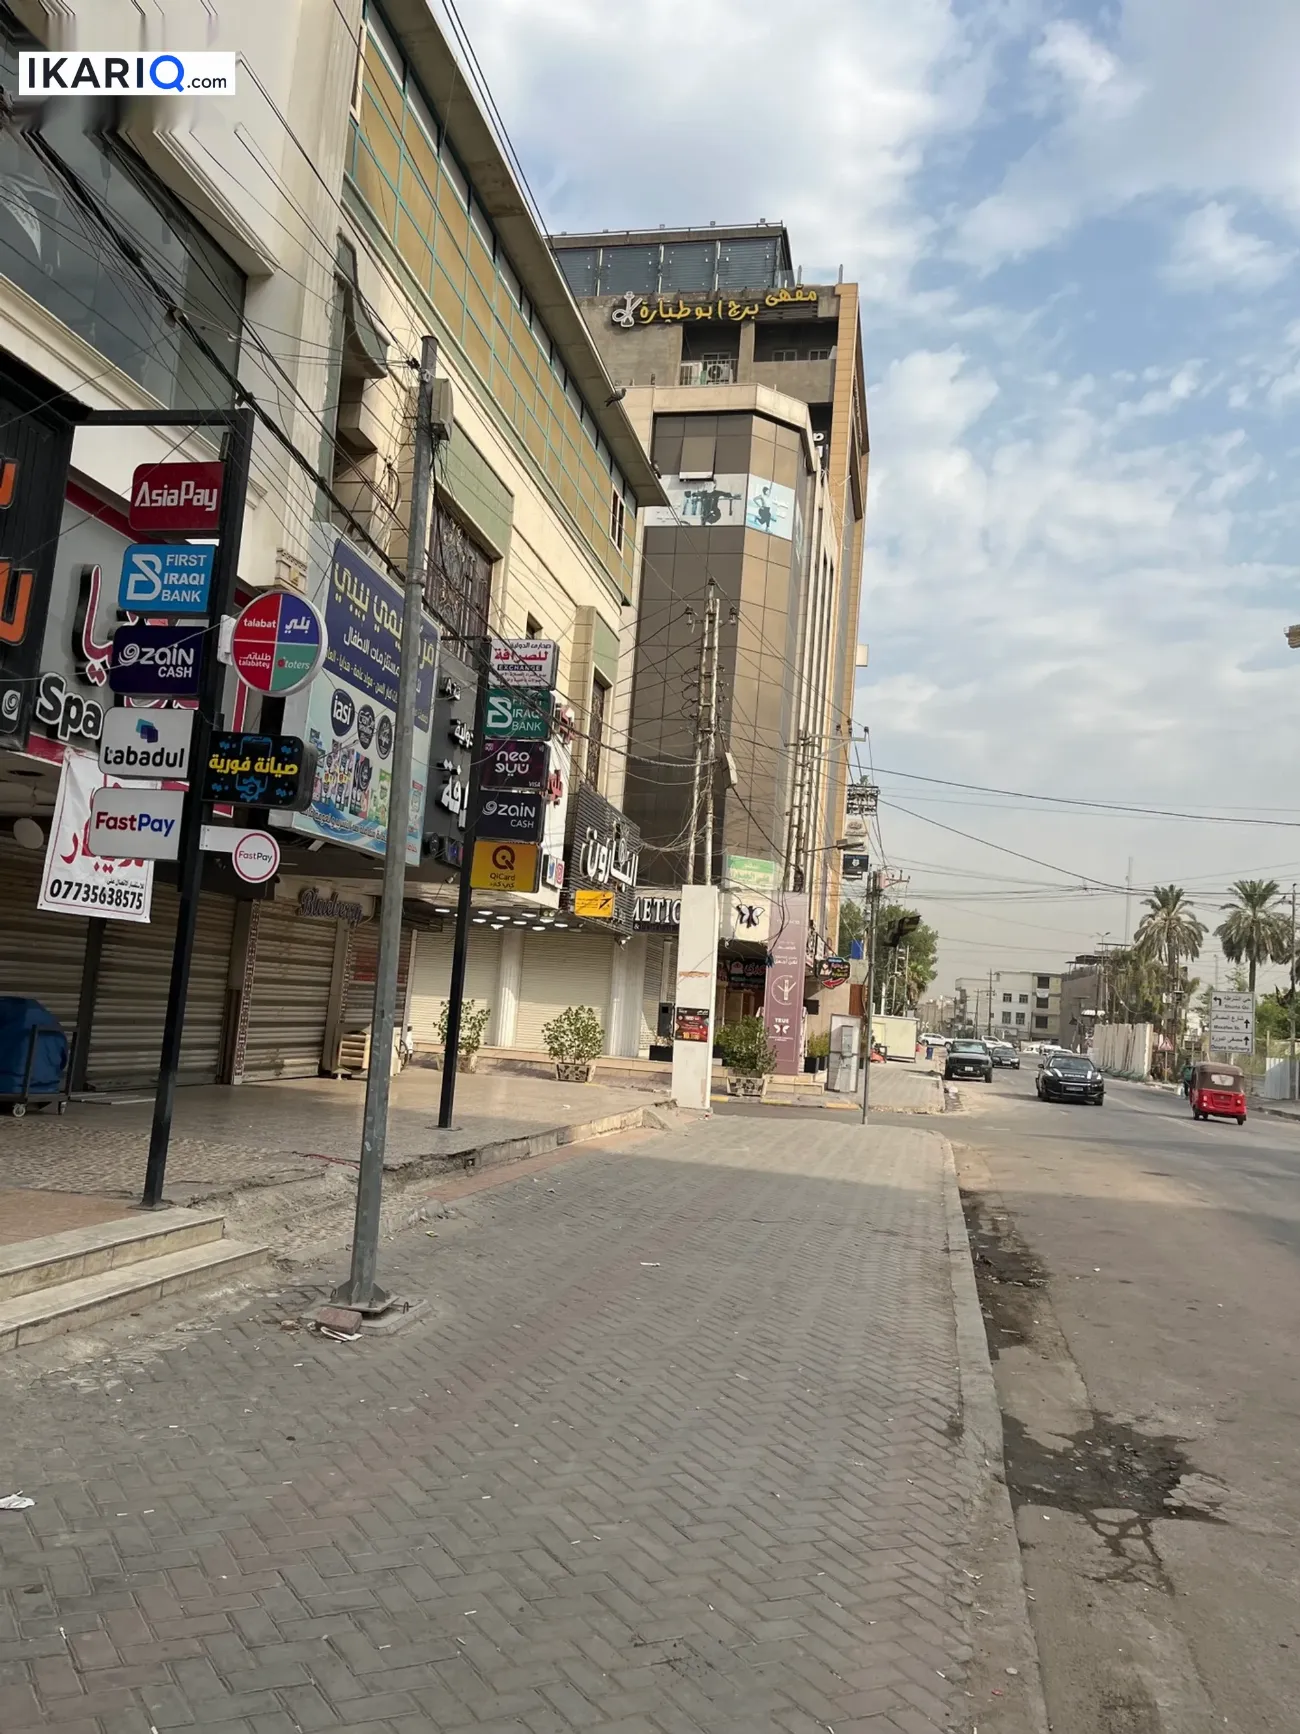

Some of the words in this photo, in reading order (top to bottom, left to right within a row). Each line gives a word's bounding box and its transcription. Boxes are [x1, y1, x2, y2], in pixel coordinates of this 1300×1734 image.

[765, 284, 817, 307] مقهى
[134, 481, 218, 512] AsiaPay
[166, 554, 207, 567] FIRST
[163, 573, 205, 586] IRAQI
[161, 590, 202, 603] BANK
[243, 618, 277, 629] talabat
[140, 644, 194, 666] zain
[283, 659, 311, 670] toters
[498, 664, 542, 672] EXCHANGE
[158, 666, 193, 679] CASH
[36, 672, 103, 740] Spa
[333, 695, 351, 726] iasi
[512, 721, 542, 732] BANK
[104, 746, 185, 768] tabadul
[497, 751, 530, 762] neo
[208, 754, 251, 775] فورية
[254, 756, 299, 779] صيانة
[497, 803, 536, 818] zain
[95, 811, 175, 837] FastPay
[510, 819, 535, 829] CASH
[238, 850, 273, 863] FastPay
[489, 872, 516, 881] QiCard
[49, 878, 144, 911] 07735638575
